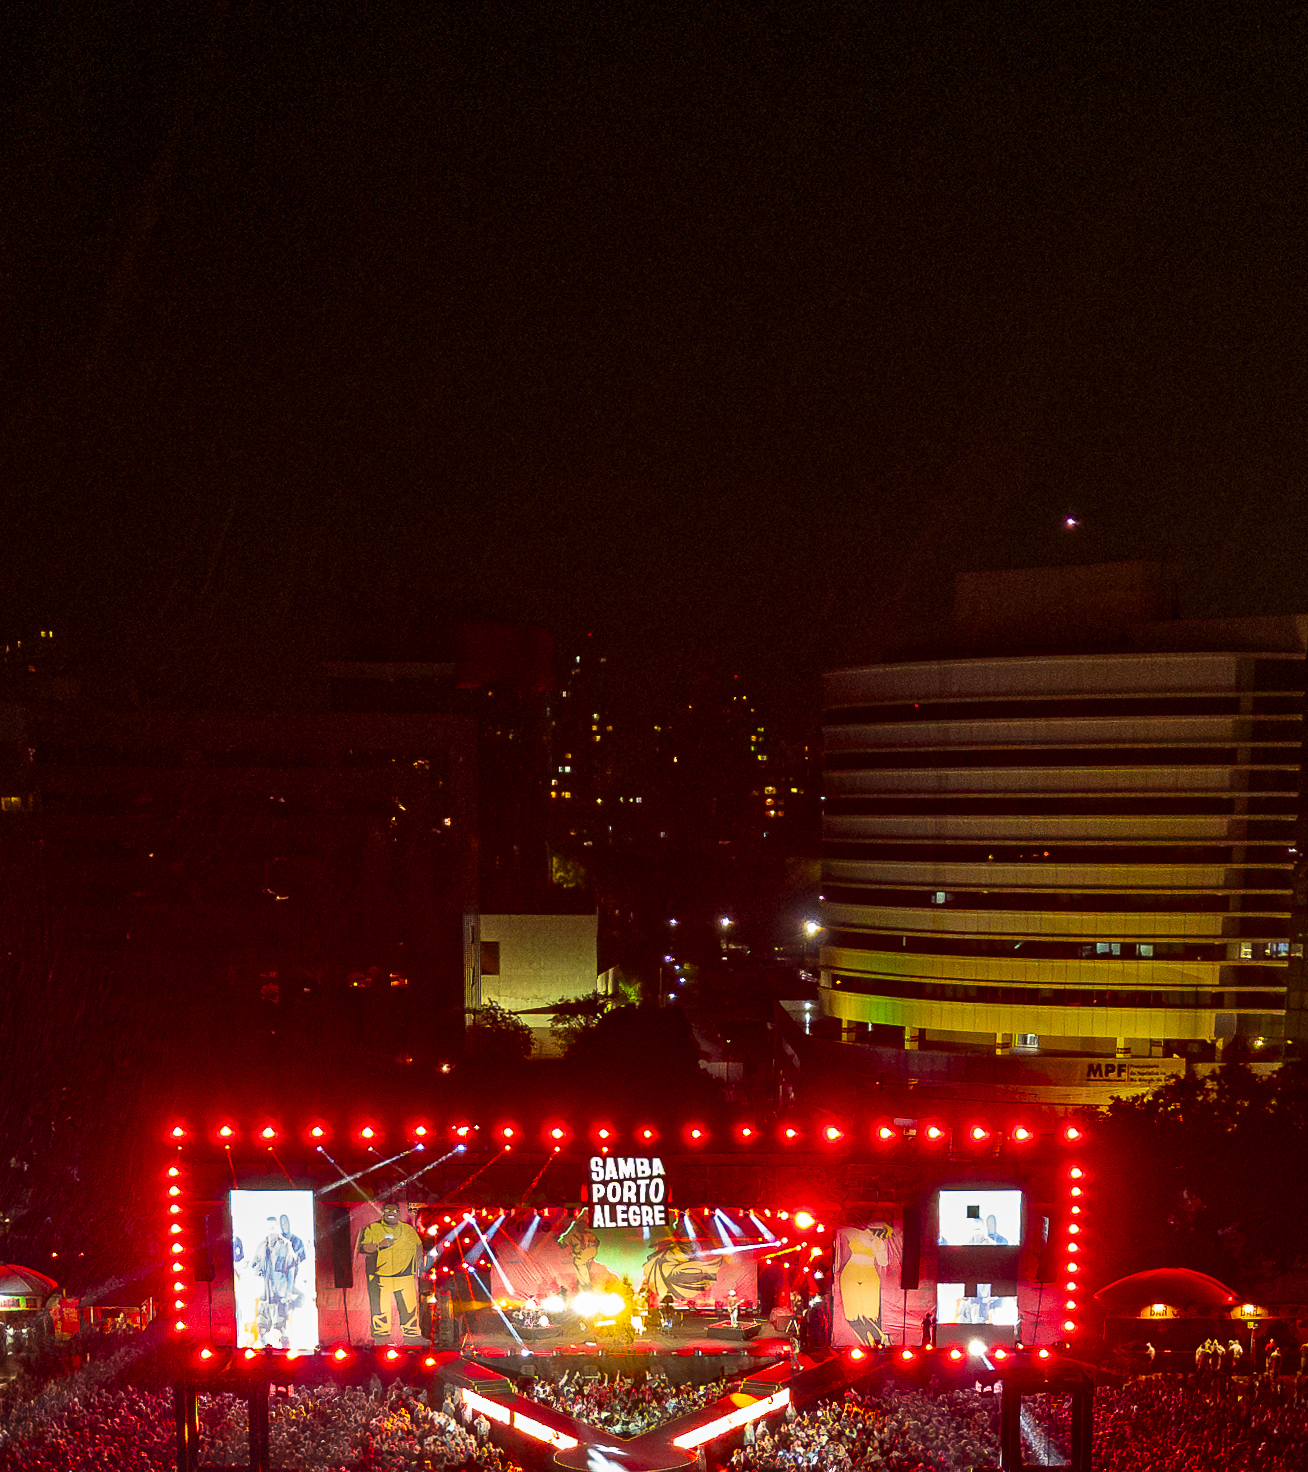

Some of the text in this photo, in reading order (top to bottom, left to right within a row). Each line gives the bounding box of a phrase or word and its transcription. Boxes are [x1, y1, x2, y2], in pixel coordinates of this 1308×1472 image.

[1087, 1063, 1126, 1078] MPF
[590, 1156, 666, 1182] SAMBA
[591, 1177, 665, 1204] PORTO
[592, 1204, 666, 1228] ALEGRE
